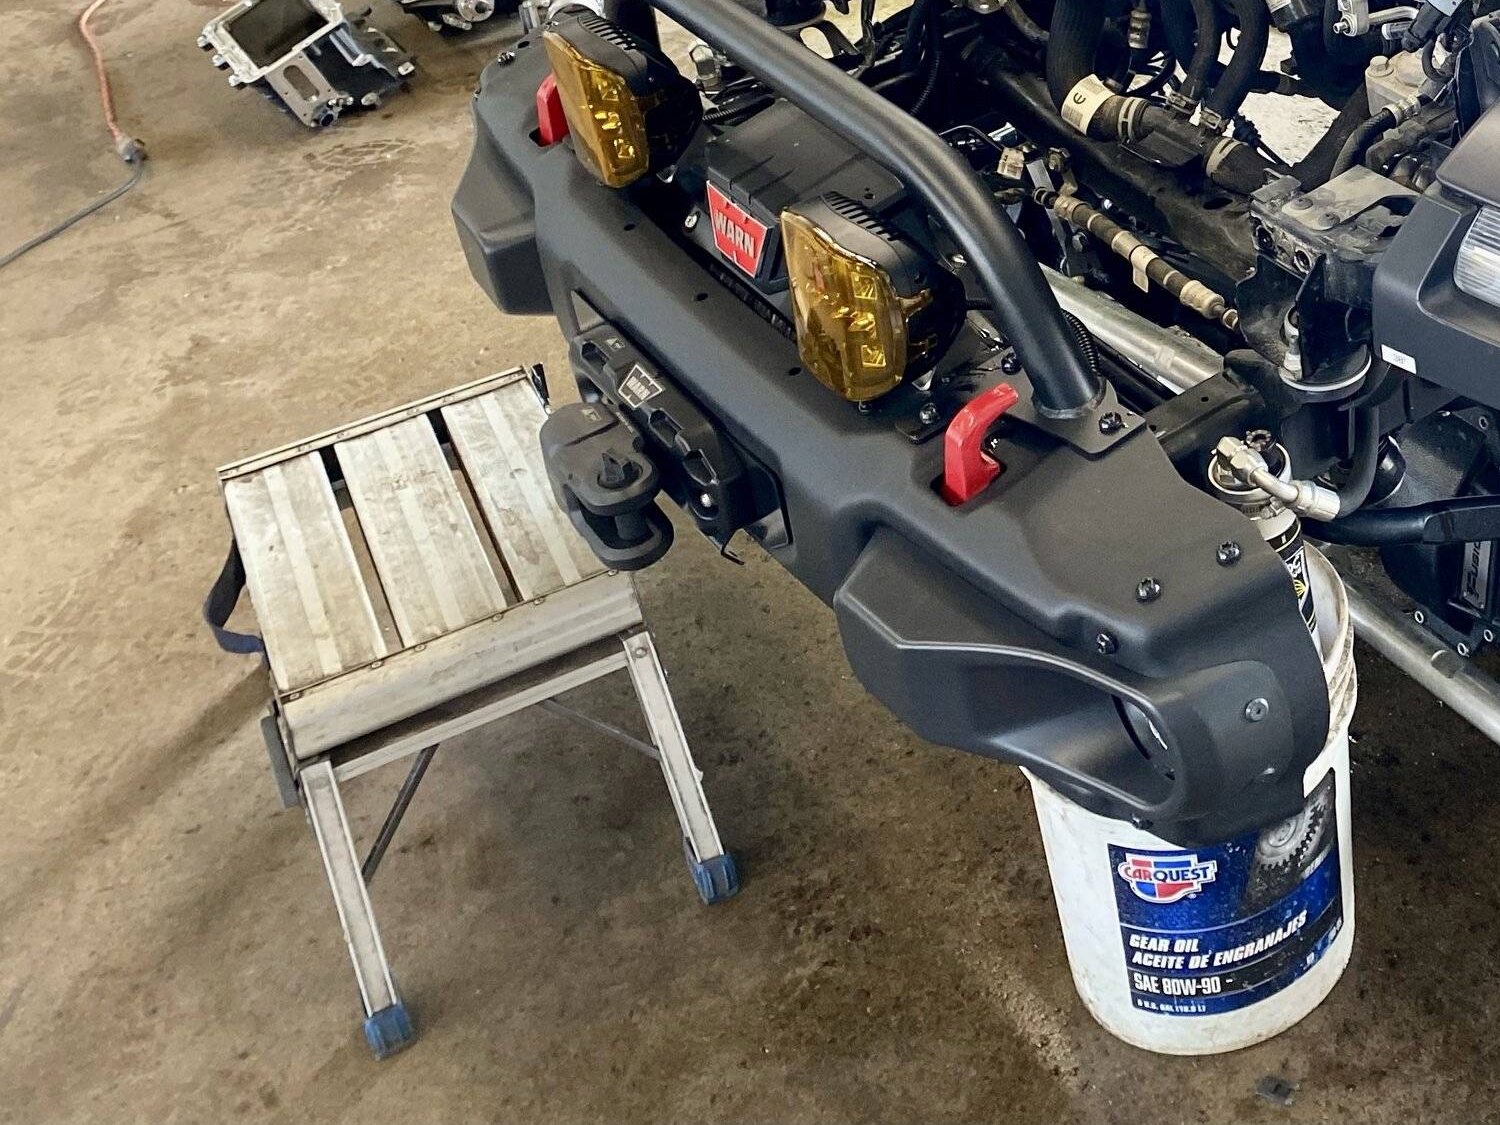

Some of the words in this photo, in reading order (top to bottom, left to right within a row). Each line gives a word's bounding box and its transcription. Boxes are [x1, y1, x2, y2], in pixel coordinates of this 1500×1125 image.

[714, 209, 755, 258] WARN
[626, 375, 651, 401] WARN
[1124, 866, 1210, 882] CARQUEST
[1129, 934, 1169, 952] GEAR
[1173, 938, 1199, 953] OIL
[1132, 953, 1185, 969] ACEITE
[1189, 956, 1209, 970] DE
[1213, 910, 1308, 966] ENGRANAJES
[1133, 974, 1160, 993] SAE
[1162, 976, 1221, 996] 80W-90
